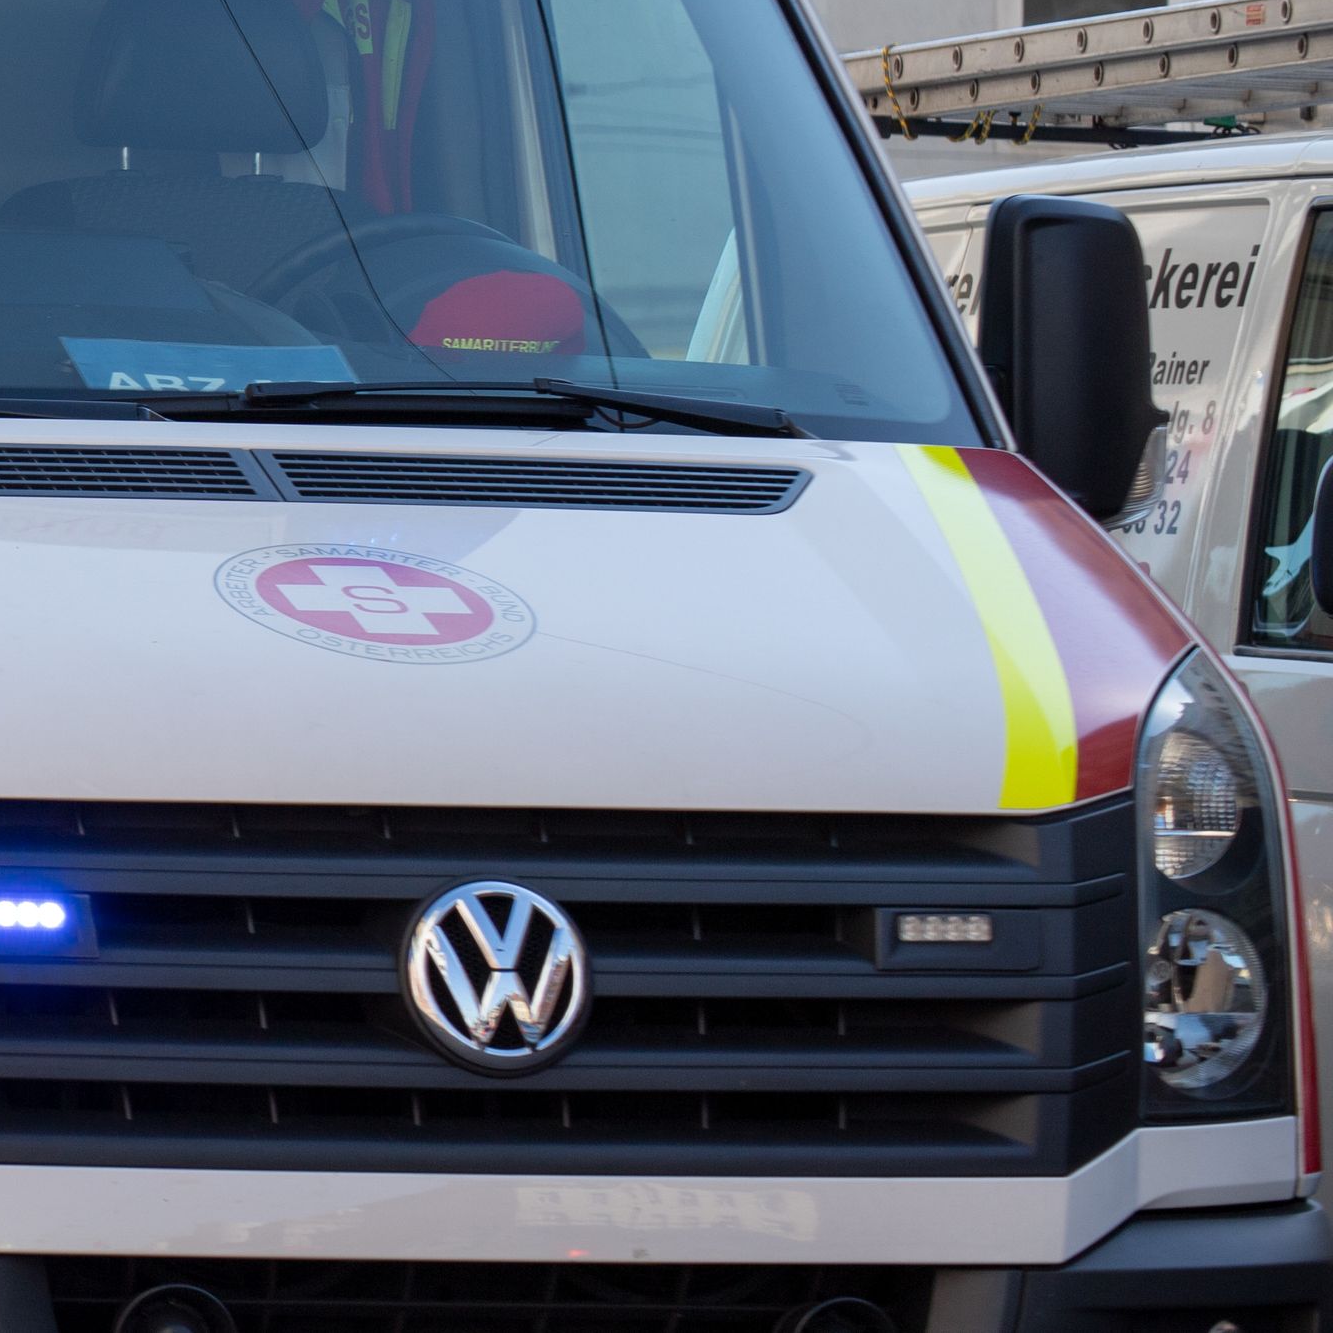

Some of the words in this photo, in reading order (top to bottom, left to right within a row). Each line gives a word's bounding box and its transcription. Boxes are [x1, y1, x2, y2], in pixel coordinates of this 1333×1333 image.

[1201, 399, 1216, 435] 8
[1153, 499, 1182, 535] 32
[225, 557, 276, 618] ARBEITER
[273, 546, 462, 578] SAMARITER
[476, 583, 526, 624] BUND
[340, 584, 410, 615] S
[296, 627, 515, 660] ÖSTERREICHS
